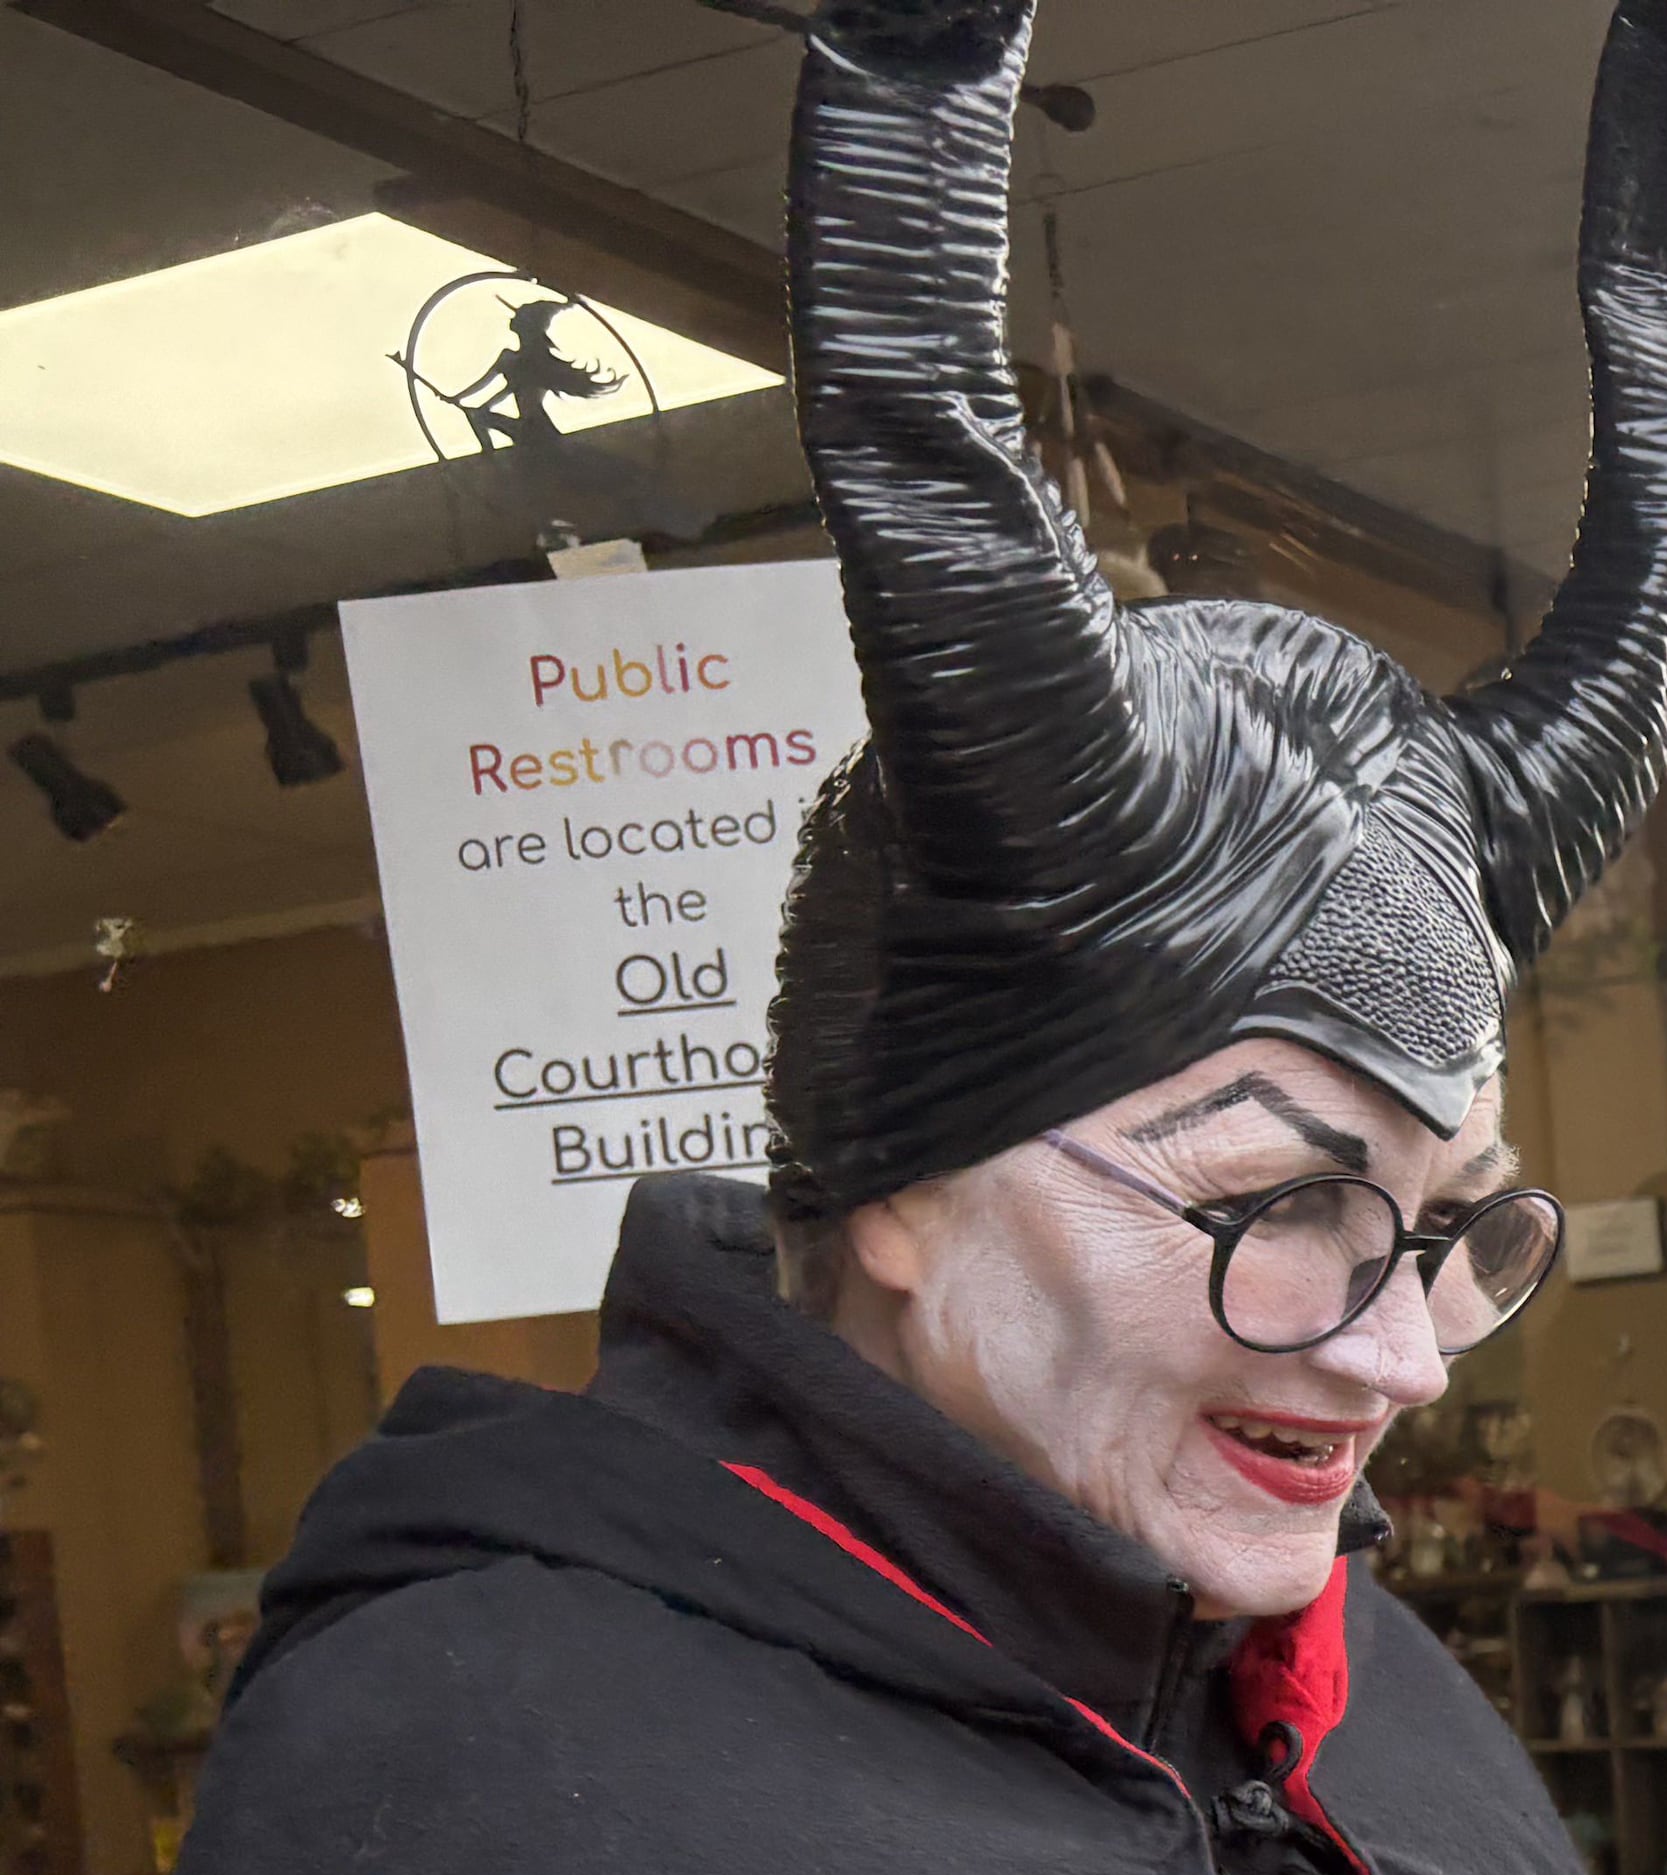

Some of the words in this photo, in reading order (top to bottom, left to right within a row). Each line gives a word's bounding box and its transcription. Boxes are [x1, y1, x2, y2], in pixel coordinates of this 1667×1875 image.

[530, 642, 731, 708] Public
[469, 728, 816, 797] Restrooms
[457, 831, 547, 872] are
[563, 798, 777, 861] located
[613, 881, 708, 928] the
[615, 946, 729, 1006] Old
[493, 1033, 762, 1101] Courtho
[551, 1111, 768, 1177] Buildin
